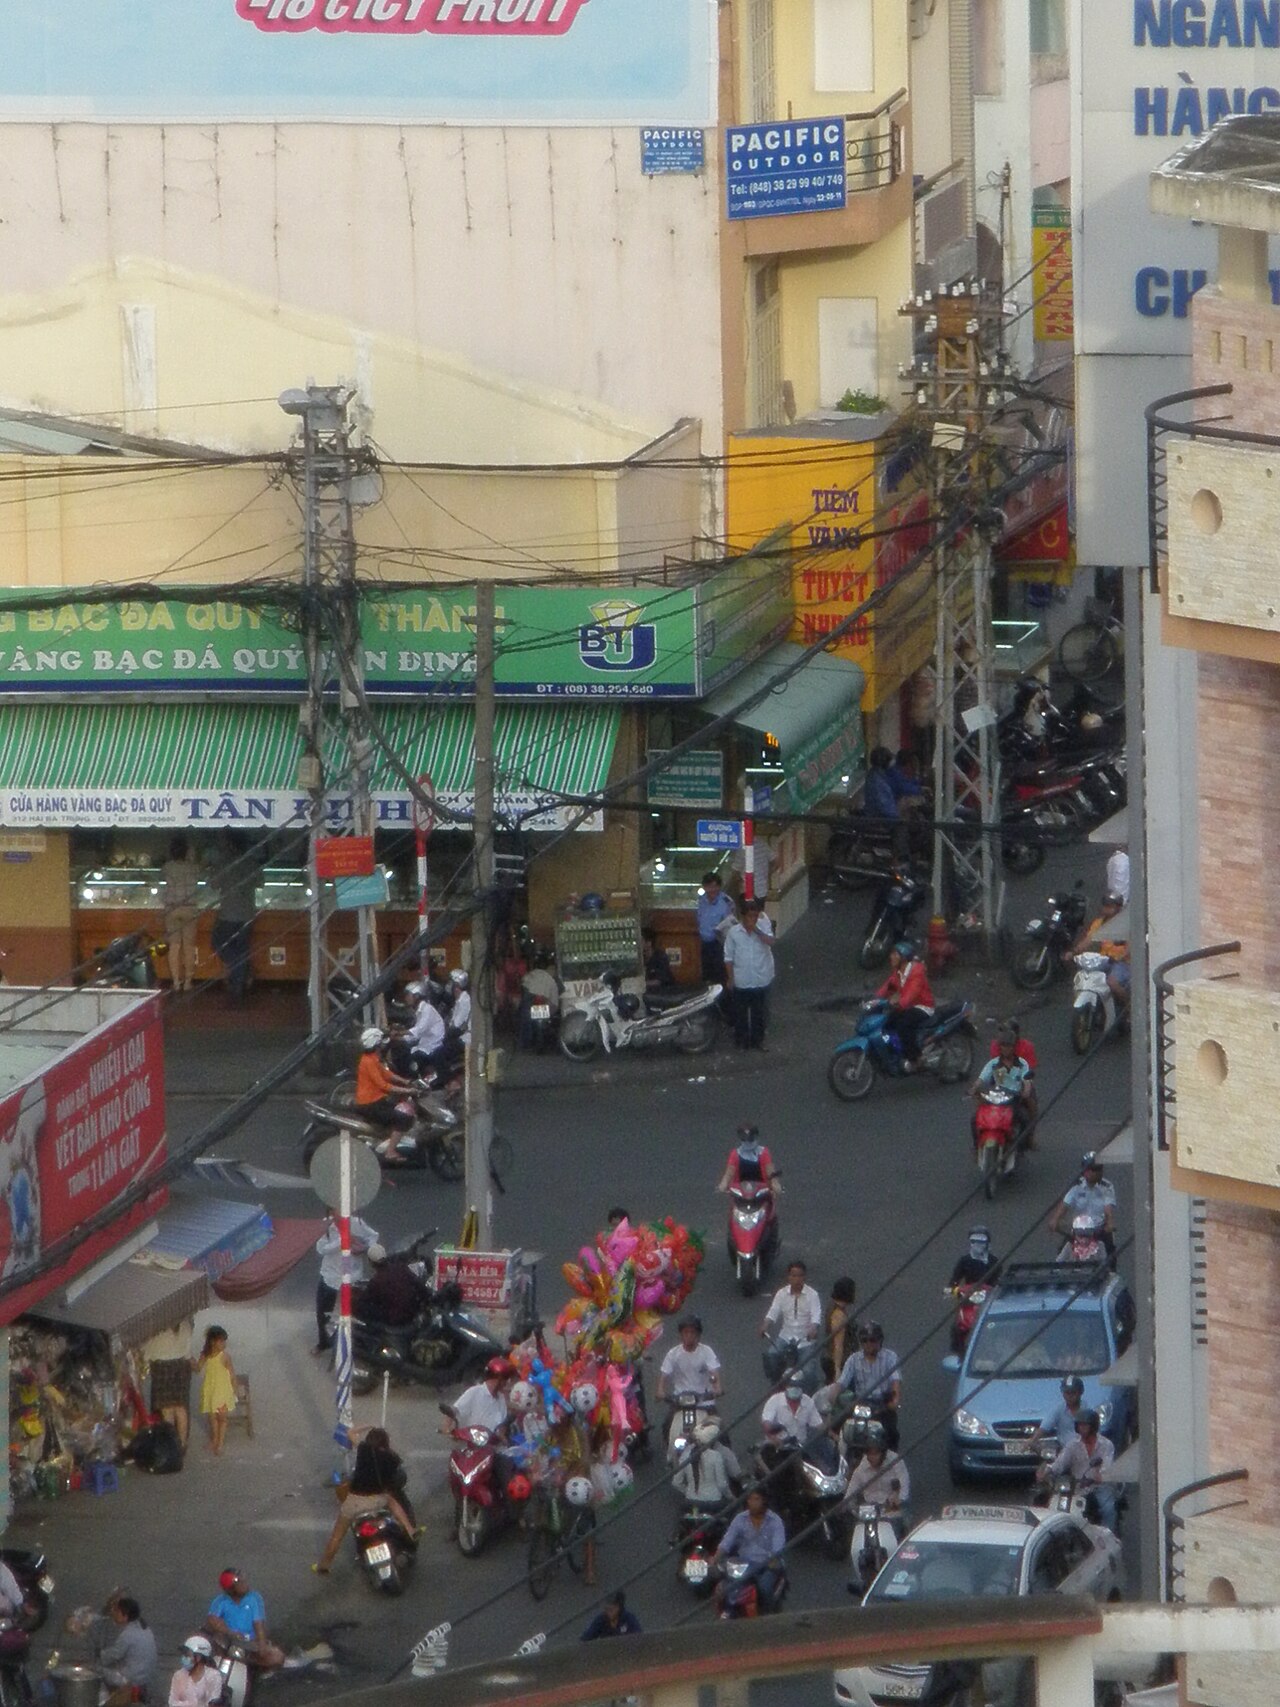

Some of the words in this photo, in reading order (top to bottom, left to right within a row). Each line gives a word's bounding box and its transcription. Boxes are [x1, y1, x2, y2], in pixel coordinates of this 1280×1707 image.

[643, 130, 702, 140] PACIFIC
[731, 125, 840, 153] PACIFIC
[732, 150, 840, 172] OUTDOOR
[730, 184, 748, 196] Tel:
[811, 483, 859, 519] TIỆM
[0, 645, 84, 672] ÀNG
[93, 649, 163, 675] BẠC
[173, 643, 222, 670] ĐÁ
[233, 643, 304, 673] QUÝ
[36, 793, 68, 812] HÀNG
[71, 793, 101, 812] VÀNG
[150, 794, 173, 813] QUÝ
[181, 792, 274, 820] TÂN
